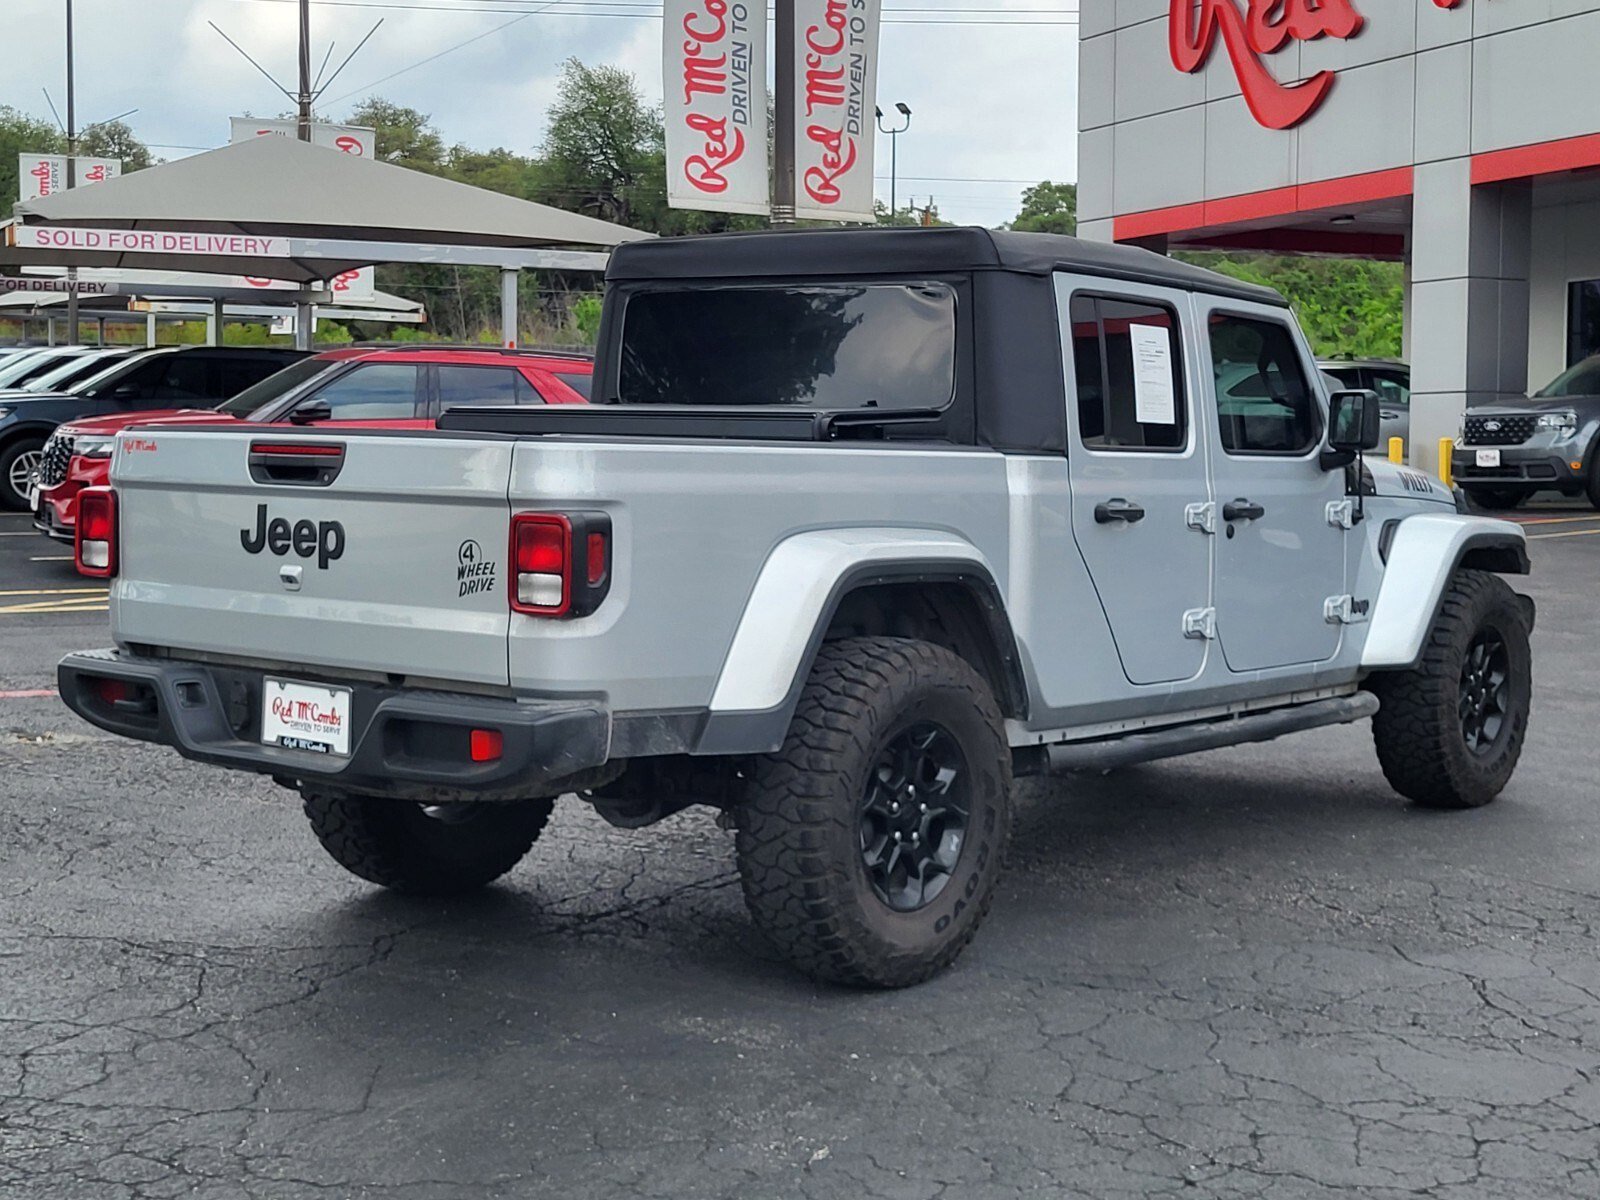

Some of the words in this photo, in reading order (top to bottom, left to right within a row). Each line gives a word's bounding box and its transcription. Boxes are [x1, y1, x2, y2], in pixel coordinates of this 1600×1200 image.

[731, 3, 748, 34] TO
[849, 17, 866, 46] TO
[731, 41, 748, 126] DRIVEN
[847, 53, 863, 136] DRIVEN
[684, 113, 745, 193] Red
[804, 124, 856, 204] Red
[31, 161, 50, 196] ombs
[51, 161, 59, 189] SERVE
[36, 229, 100, 247] SOLD
[108, 233, 155, 250] FOR
[162, 235, 273, 254] DELIVERY
[32, 280, 107, 293] DELIVERY
[240, 503, 345, 569] Jeep
[462, 543, 475, 563] 4
[457, 561, 496, 581] WHEEL
[458, 577, 496, 598] DRIVE
[272, 696, 293, 725] Red
[295, 700, 342, 726] McCombs
[290, 720, 312, 732] DRIVEN
[313, 724, 322, 732] TO
[323, 726, 342, 736] SERVE
